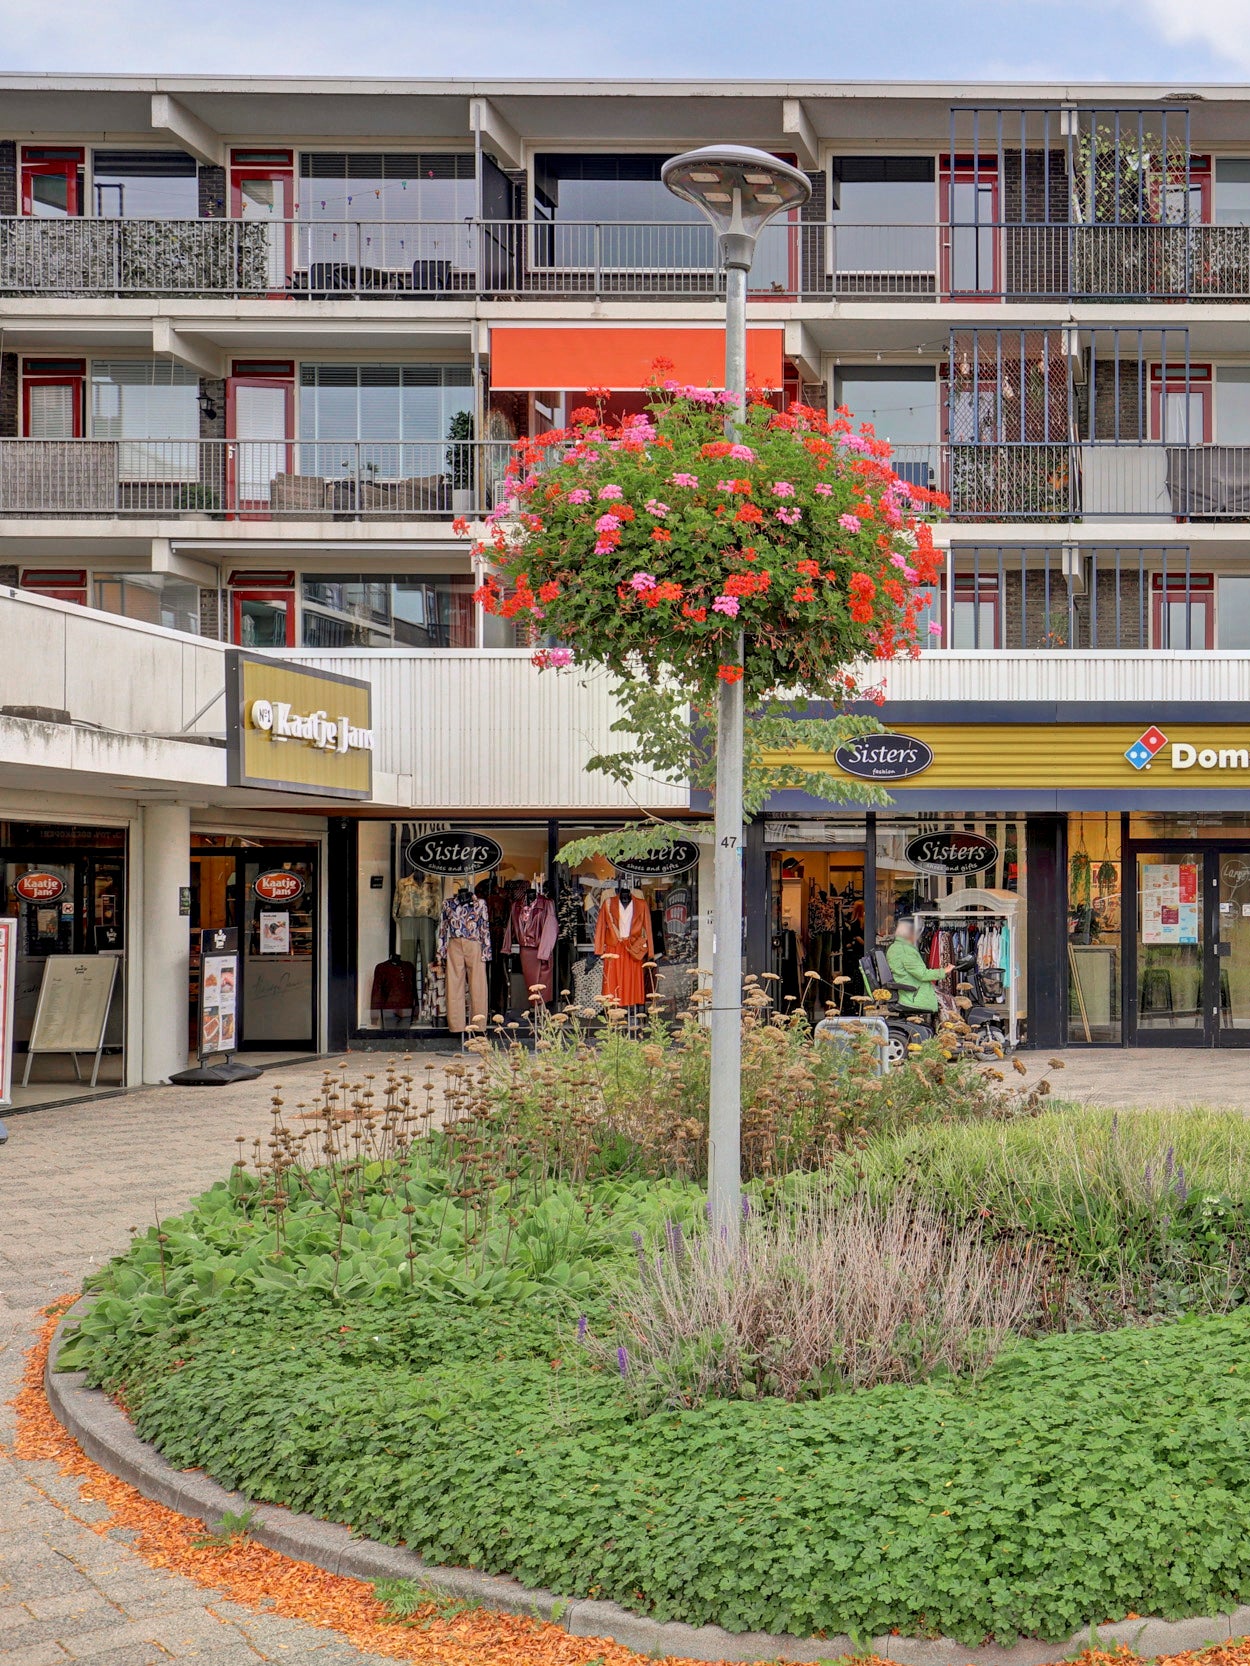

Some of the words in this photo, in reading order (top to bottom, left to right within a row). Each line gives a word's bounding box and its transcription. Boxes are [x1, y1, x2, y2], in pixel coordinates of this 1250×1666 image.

[272, 702, 337, 749] Kaatje
[848, 743, 919, 764] Sisters
[720, 836, 737, 848] 47
[420, 840, 490, 862] Sisters
[917, 841, 986, 862] Sisters
[23, 878, 59, 890] Kaatje
[262, 877, 297, 890] Kaatje
[33, 888, 54, 898] Jans
[272, 887, 291, 897] Jans
